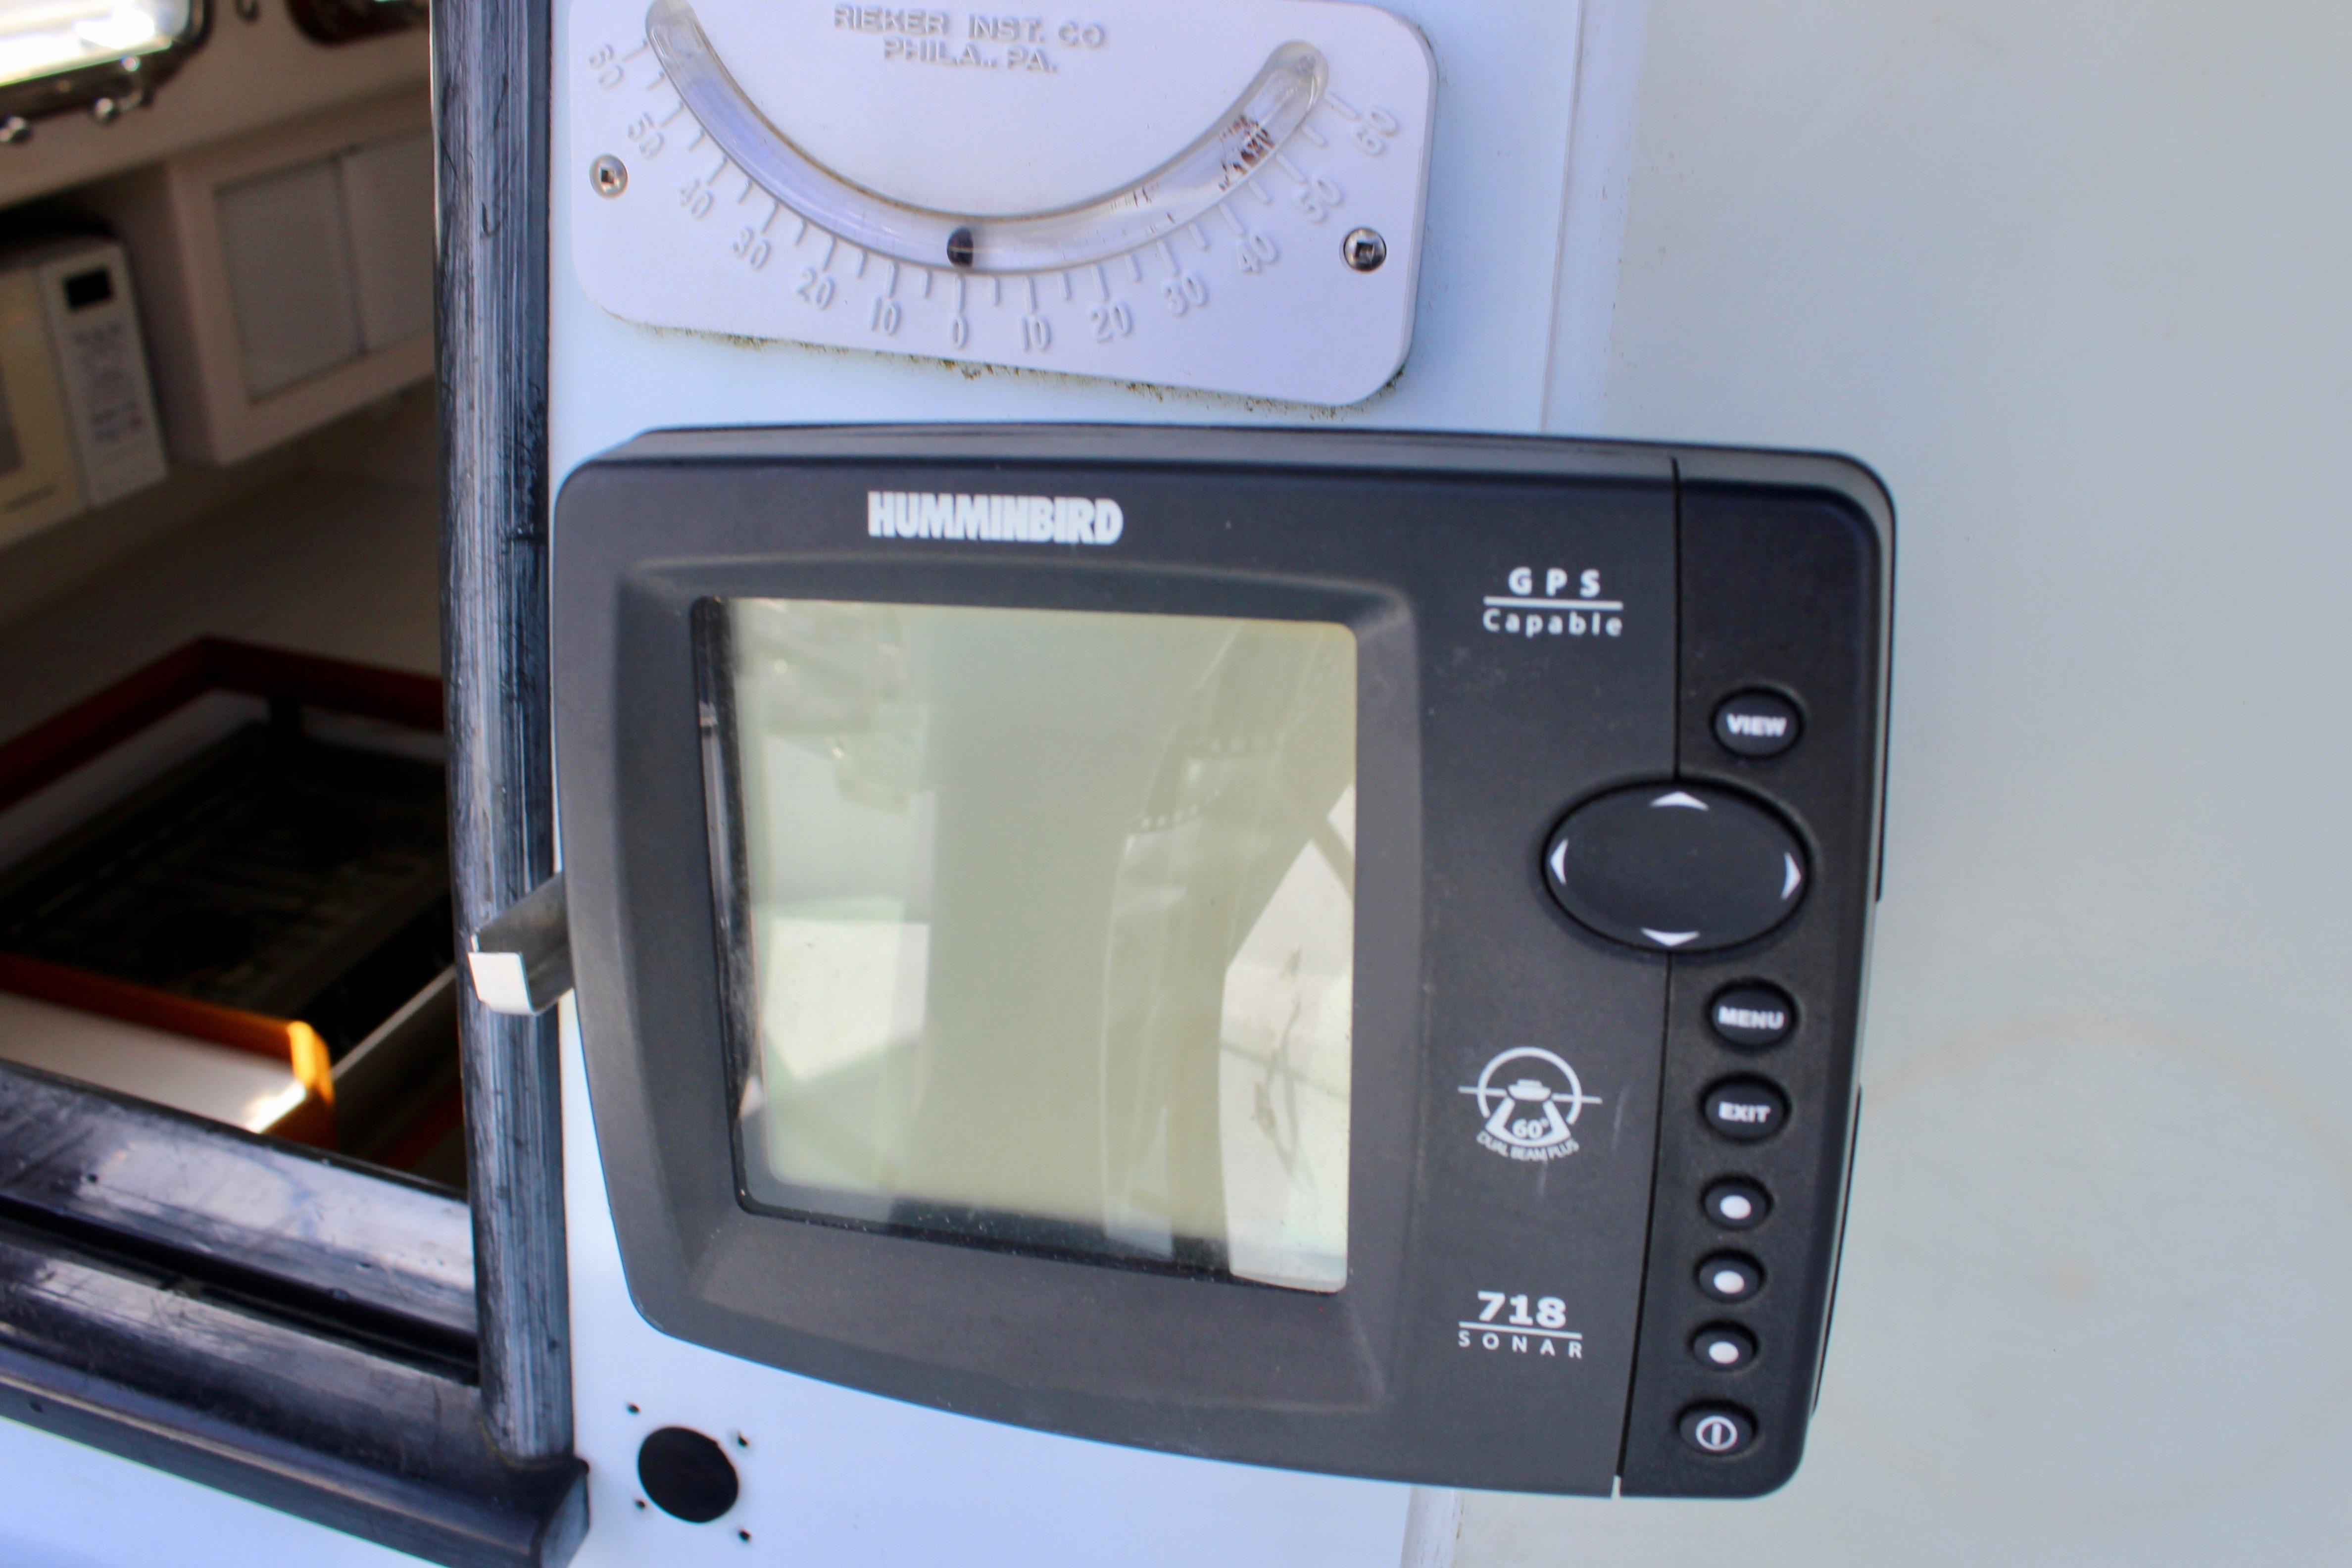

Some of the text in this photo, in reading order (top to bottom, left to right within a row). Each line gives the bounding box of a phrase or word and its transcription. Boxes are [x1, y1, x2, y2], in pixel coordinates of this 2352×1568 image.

[834, 4, 949, 35] RIEKER
[627, 112, 665, 157] 50
[1352, 105, 1399, 156] 60
[680, 179, 714, 220] 40
[1296, 176, 1343, 223] 50
[733, 226, 772, 270] 30
[1235, 230, 1278, 273] 40
[796, 268, 834, 310] 20
[1163, 274, 1207, 315] 30
[871, 297, 901, 336] 10
[952, 315, 968, 349] 0
[1019, 316, 1051, 351] 10
[1090, 302, 1132, 343] 20
[868, 491, 1124, 545] HUMMINBIRD
[1508, 567, 1600, 597] GPS
[1483, 608, 1623, 637] Capable
[1727, 714, 1787, 736] VIEW
[1718, 1007, 1784, 1029] MENU
[1718, 1102, 1770, 1123] EXIT
[1476, 1130, 1579, 1161] DUAL BEAM PLUS
[1478, 1290, 1567, 1328] 718
[1459, 1331, 1582, 1359] SONAR
